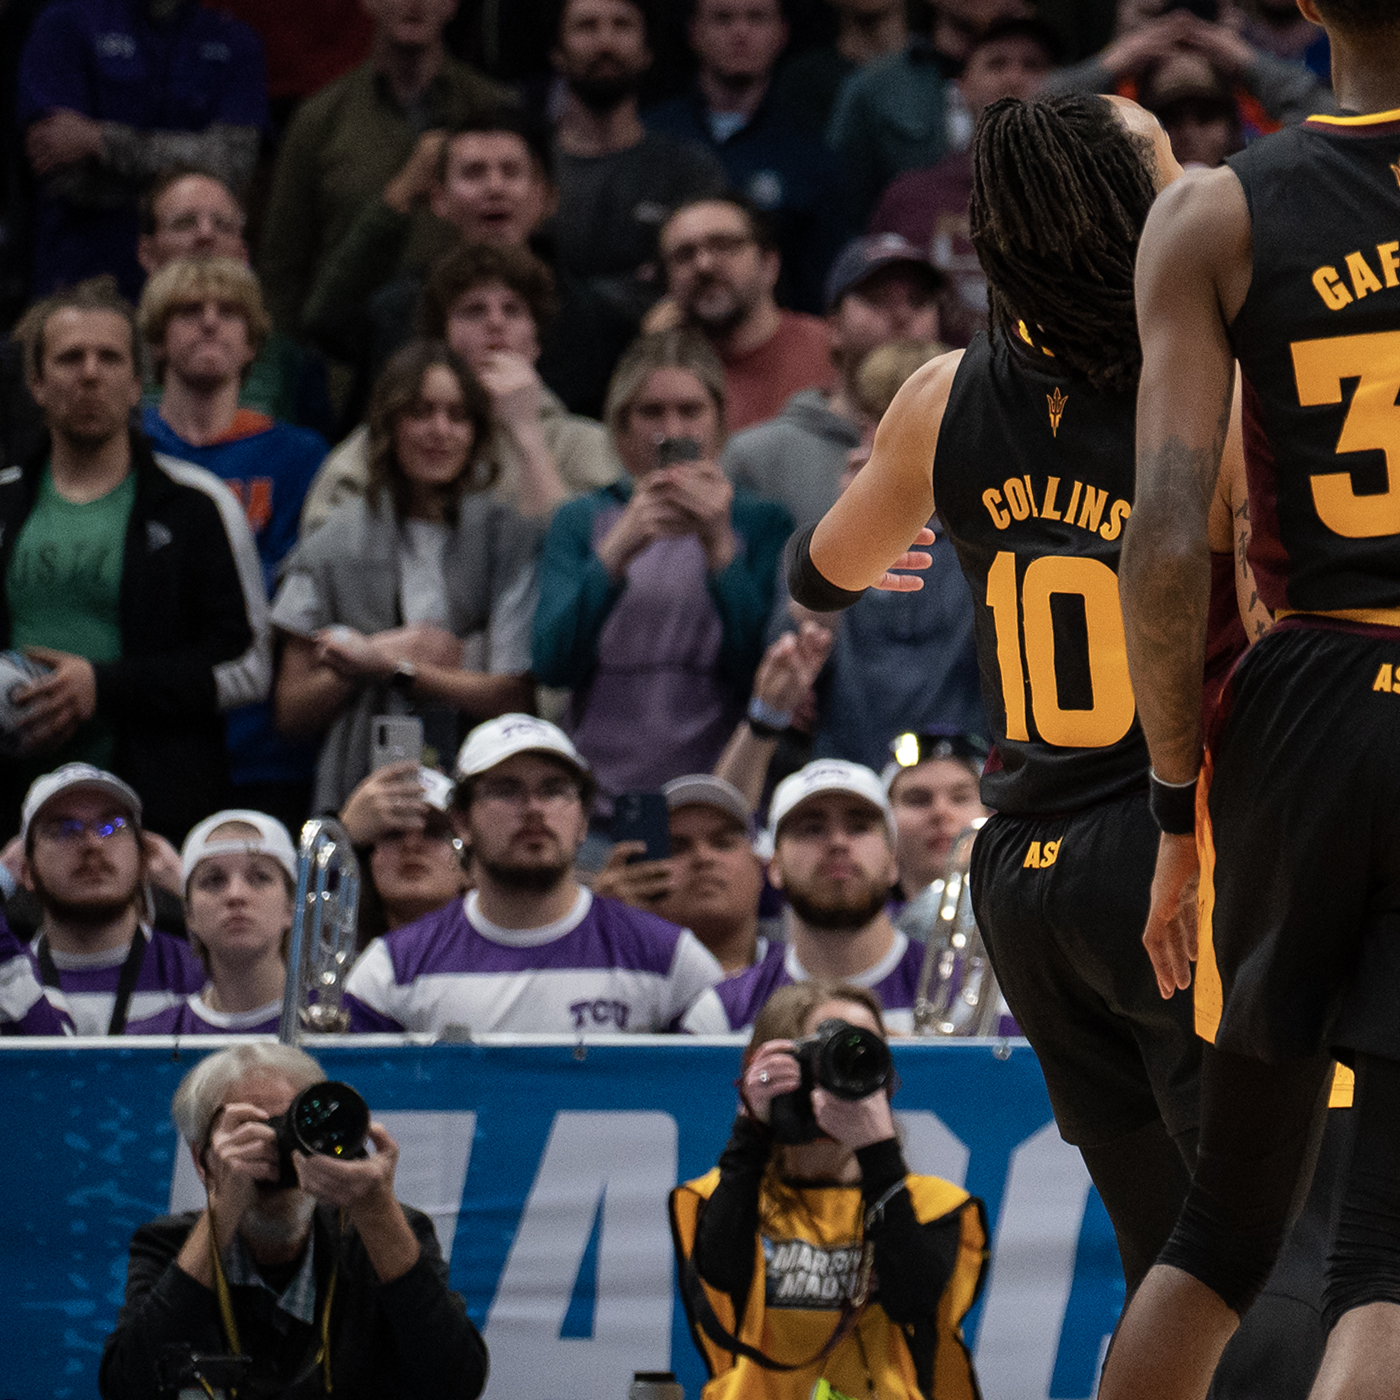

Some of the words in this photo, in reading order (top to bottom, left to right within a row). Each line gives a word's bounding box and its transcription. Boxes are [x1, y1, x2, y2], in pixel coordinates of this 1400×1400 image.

[982, 474, 1132, 541] COLLINS
[986, 550, 1136, 748] 10
[569, 999, 630, 1031] TCU
